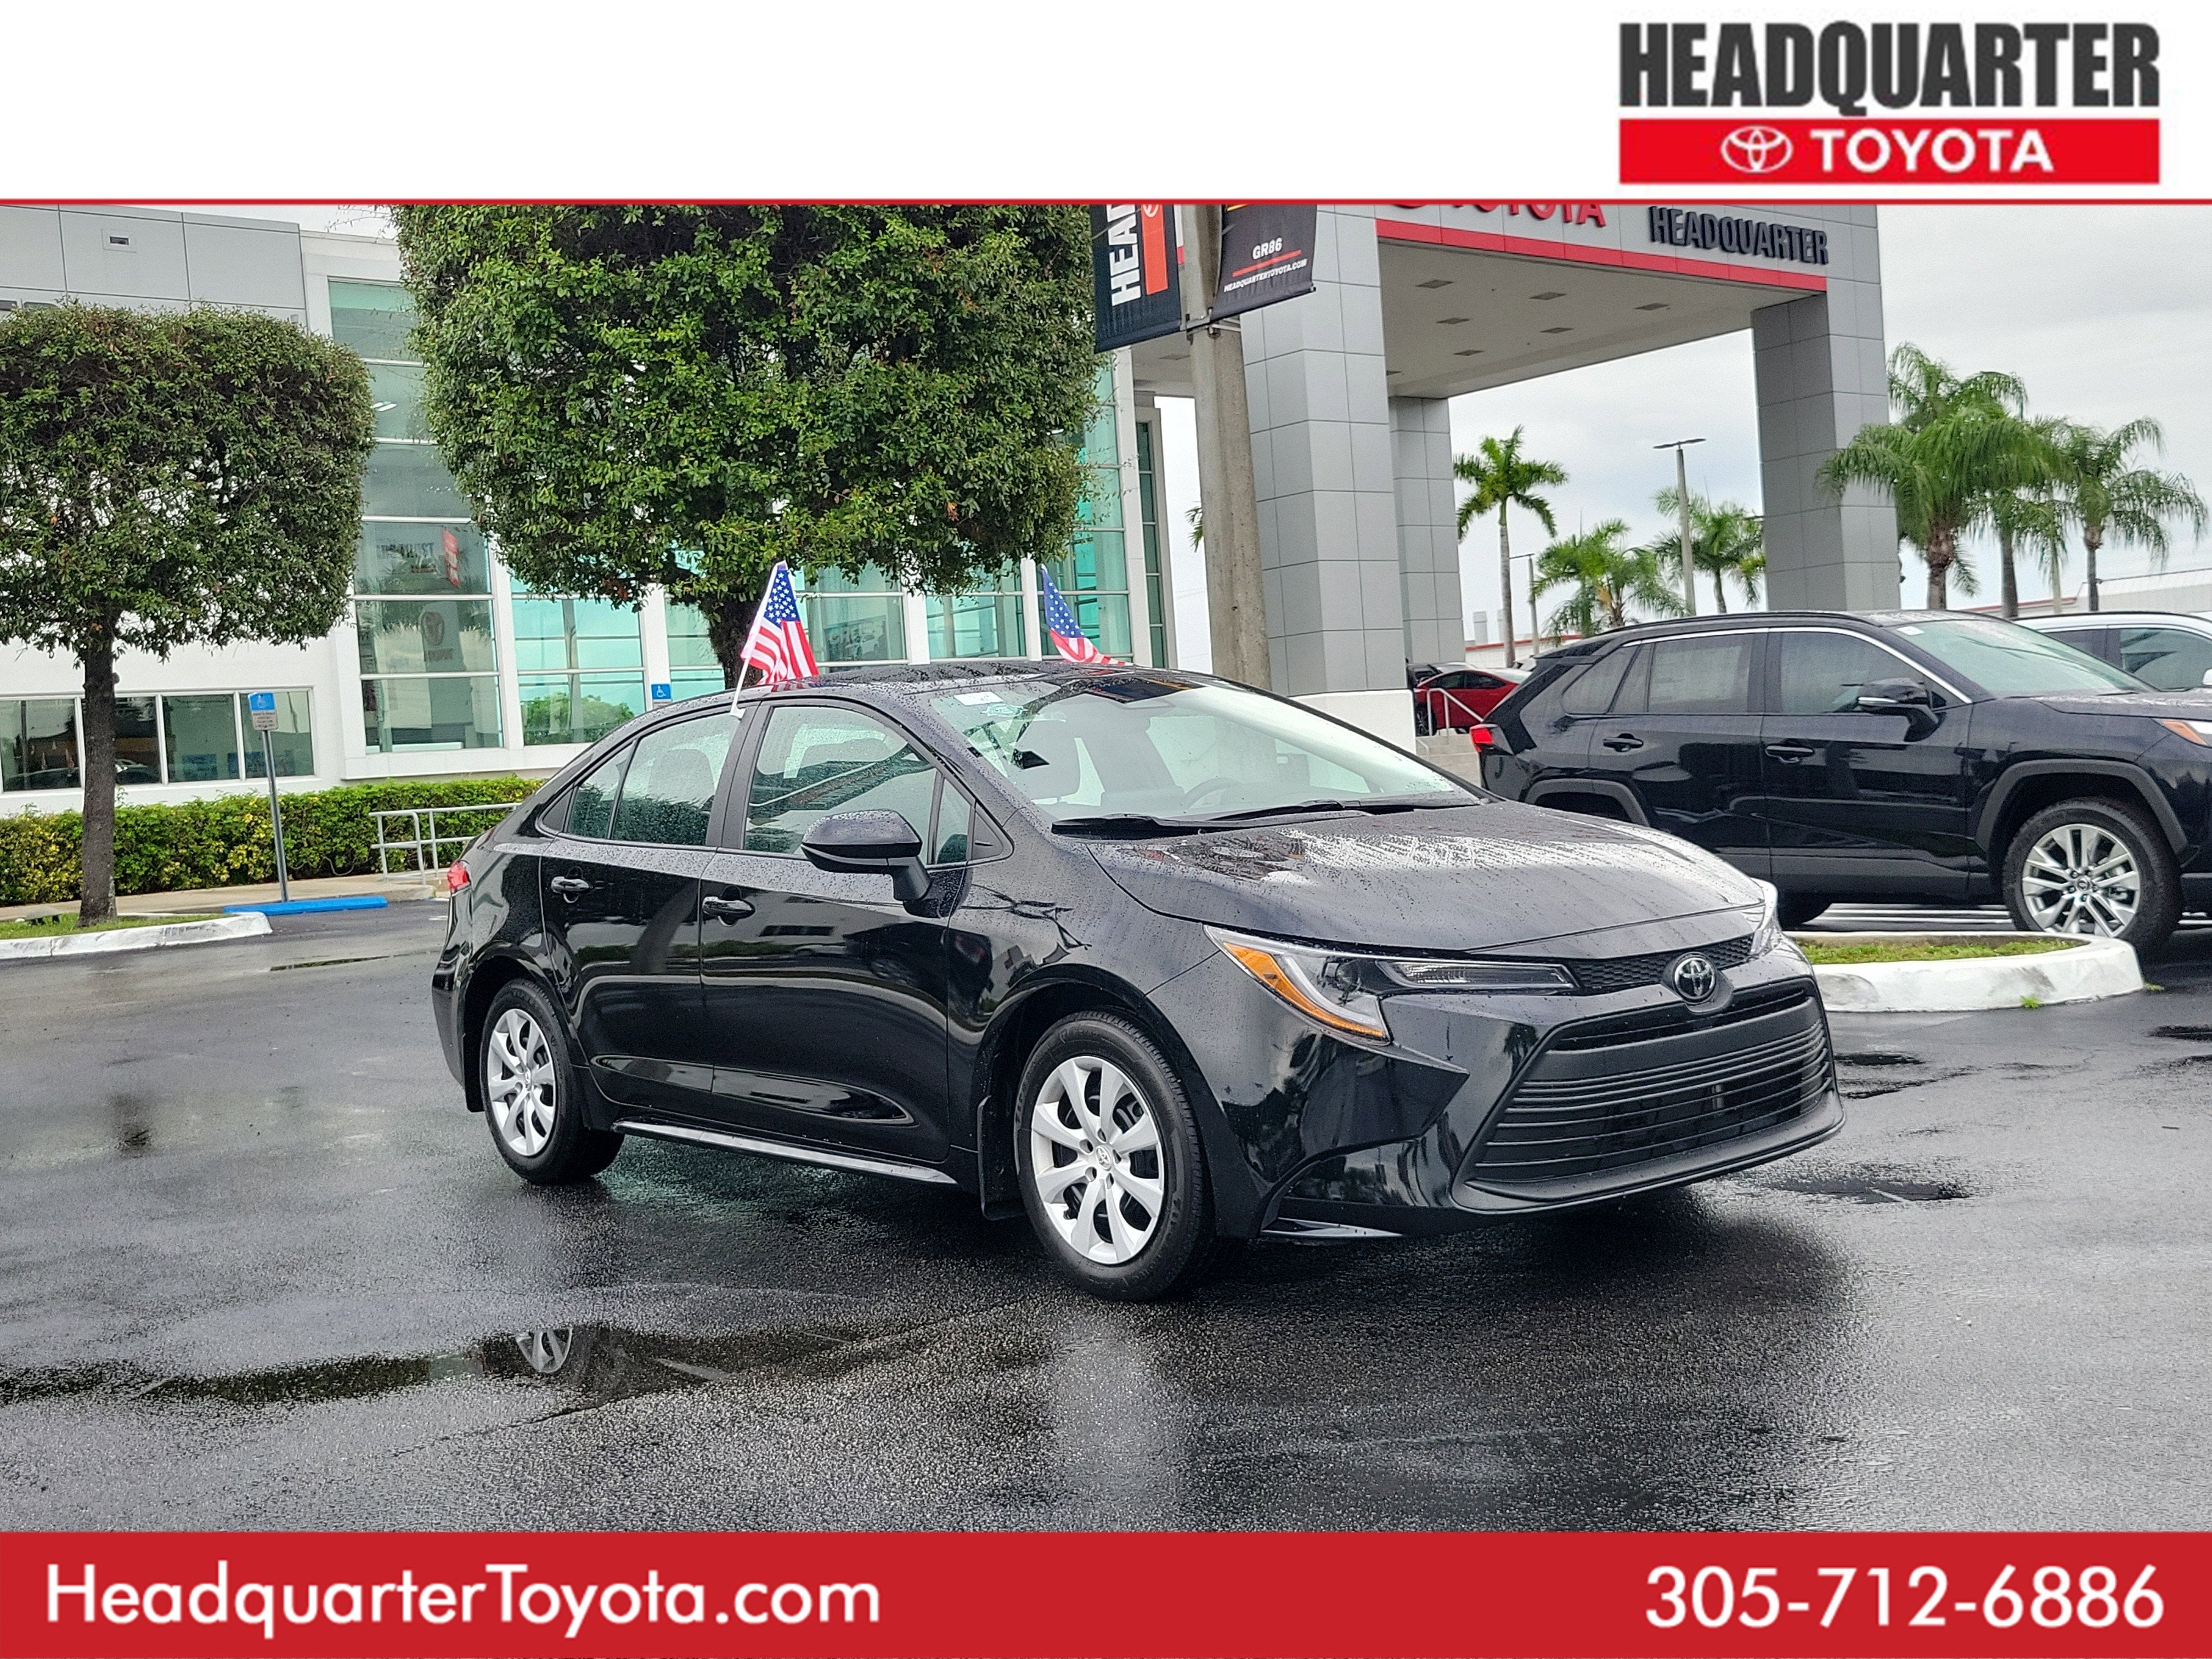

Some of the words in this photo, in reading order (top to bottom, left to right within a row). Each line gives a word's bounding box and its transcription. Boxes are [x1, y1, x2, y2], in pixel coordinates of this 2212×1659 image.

[1252, 238, 1283, 260] GR86
[1453, 205, 1606, 227] OTA
[1649, 206, 1829, 265] HEADQUARTER
[1223, 258, 1307, 292] HEADQUARTERTOYOTA.COM
